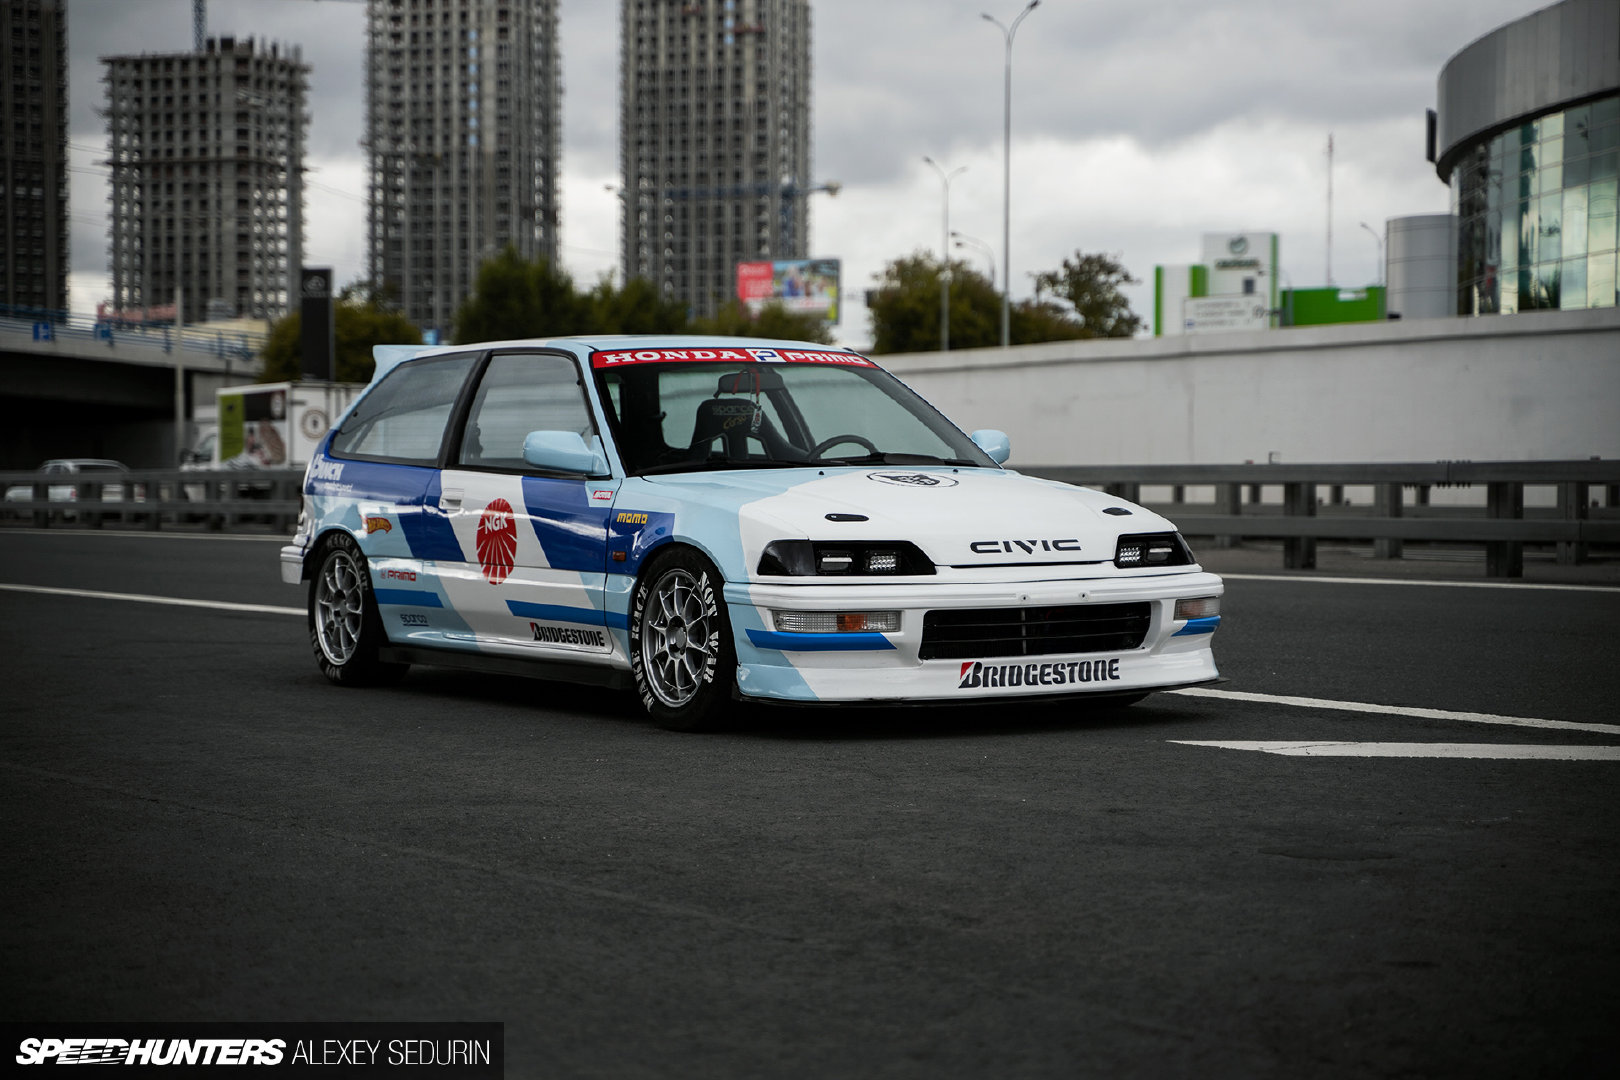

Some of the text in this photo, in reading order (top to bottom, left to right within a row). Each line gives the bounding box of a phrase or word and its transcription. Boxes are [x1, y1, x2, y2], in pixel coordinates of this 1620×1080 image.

[603, 351, 746, 364] HONDA
[784, 352, 868, 365] PRIMO
[484, 515, 507, 534] NGK
[970, 539, 1081, 555] CIVIC
[530, 622, 605, 647] BRIDGESTONE
[631, 571, 719, 713] MAKE RACE NOT WAR
[958, 658, 1120, 689] BRIDGESTONE
